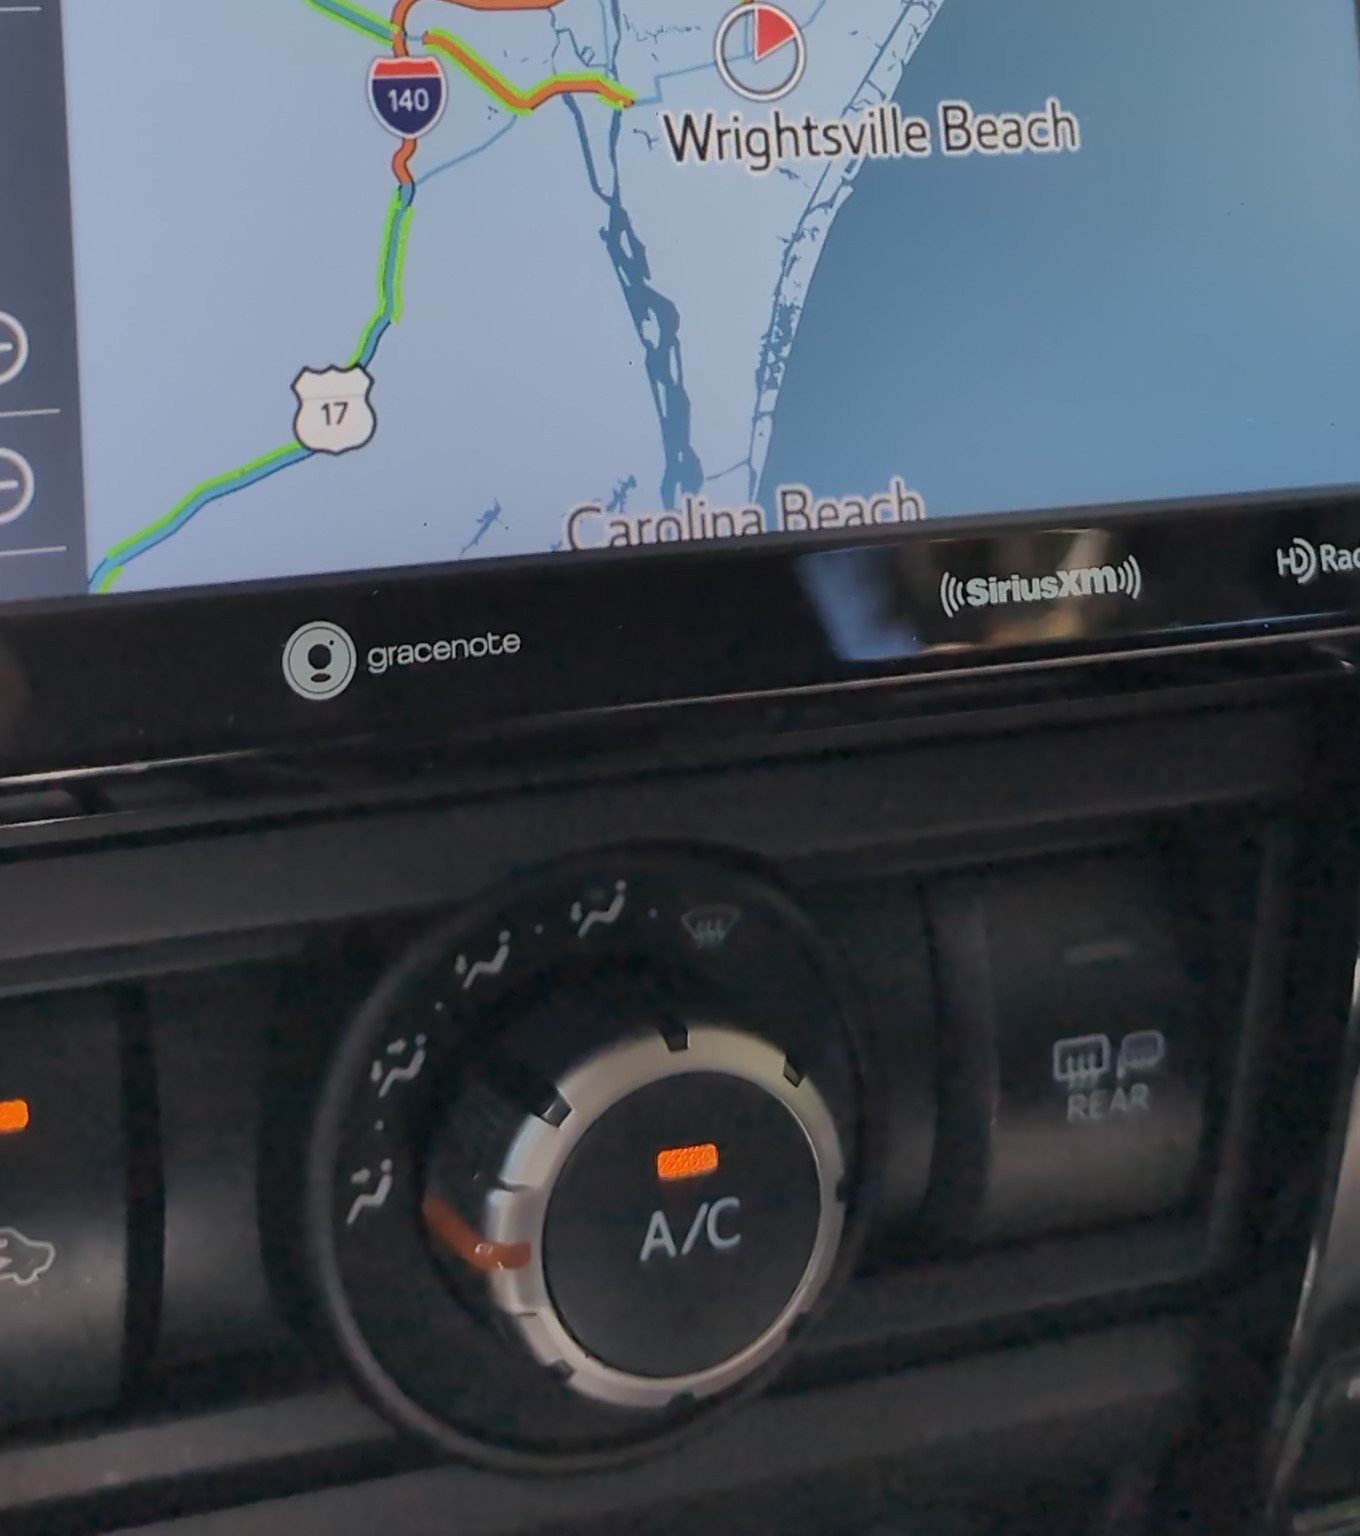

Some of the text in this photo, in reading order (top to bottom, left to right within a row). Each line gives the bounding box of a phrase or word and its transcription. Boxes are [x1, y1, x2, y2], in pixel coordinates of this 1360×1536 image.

[387, 87, 430, 113] 140
[664, 102, 1080, 172] Wrightsville Beach
[320, 401, 349, 427] 17
[566, 479, 925, 552] Carolina Beach
[366, 630, 522, 675] gracenote
[1065, 1082, 1151, 1123] REAR
[641, 1195, 742, 1263] A/C
